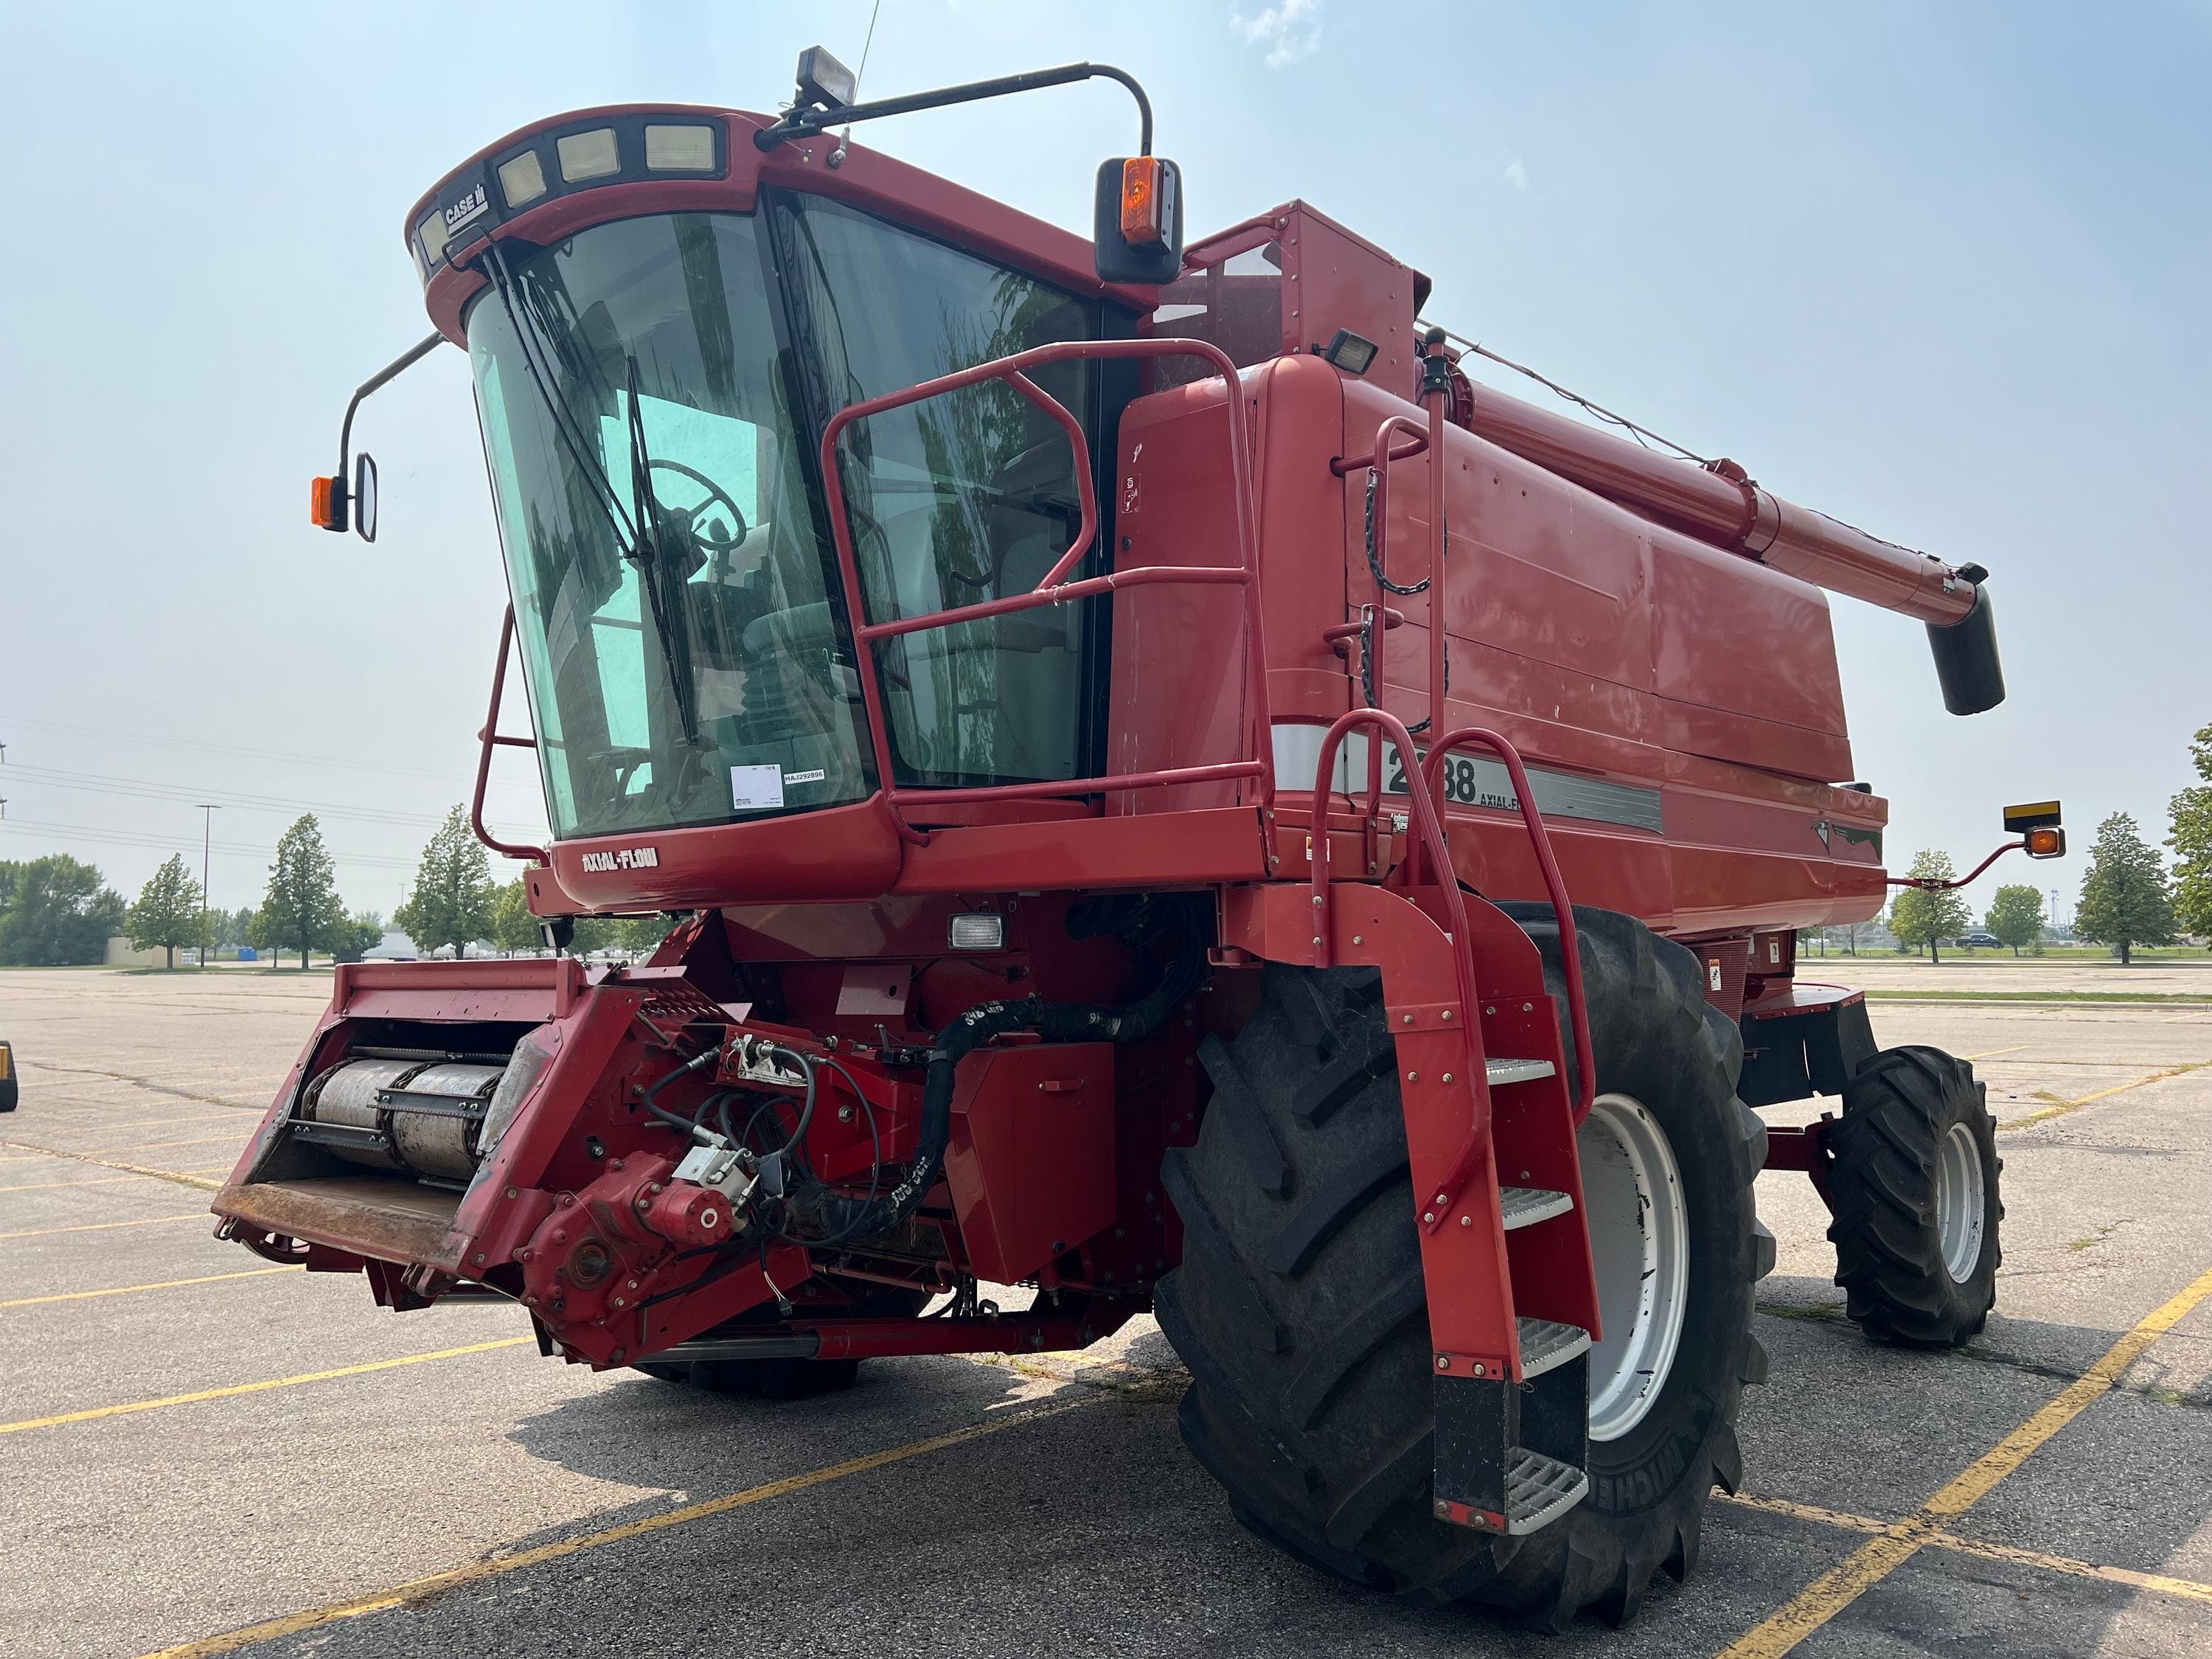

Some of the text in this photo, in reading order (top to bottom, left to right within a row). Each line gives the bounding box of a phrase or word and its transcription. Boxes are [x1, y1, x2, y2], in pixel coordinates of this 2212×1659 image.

[445, 194, 475, 224] CASE
[785, 771, 823, 782] HAJ292896
[1389, 748, 1475, 802] 288
[582, 847, 658, 872] AXIAL-FLOW
